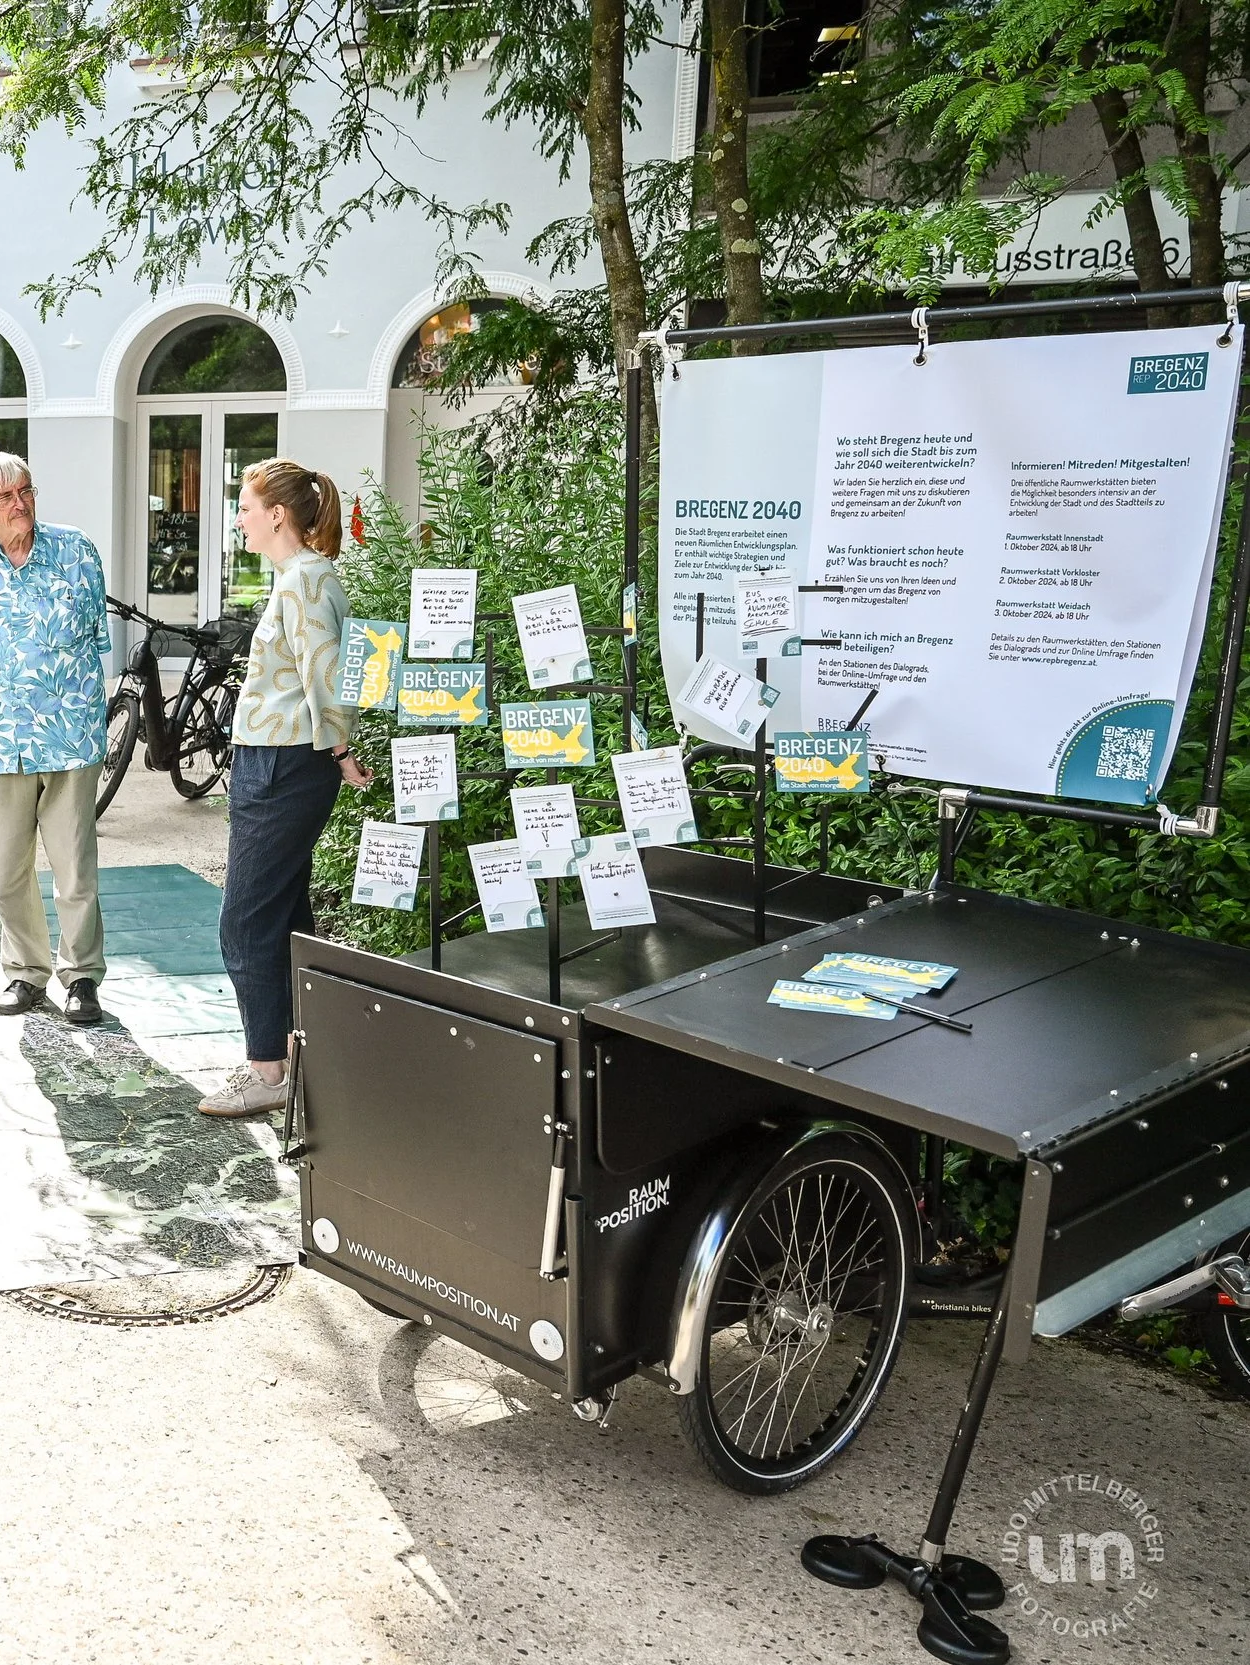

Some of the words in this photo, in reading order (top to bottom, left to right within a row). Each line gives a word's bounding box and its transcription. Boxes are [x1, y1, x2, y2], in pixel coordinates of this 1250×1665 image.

[1161, 237, 1180, 266] 6
[1134, 356, 1204, 373] BREGENZ
[1133, 374, 1150, 383] REP
[1155, 371, 1203, 390] 2040
[837, 437, 851, 445] Wo
[853, 437, 877, 445] steht
[880, 436, 921, 446] Bregenz
[924, 434, 951, 443] heute
[954, 433, 972, 443] und
[853, 449, 869, 457] soll
[872, 447, 890, 456] sich
[894, 448, 908, 456] die
[911, 447, 937, 455] Stadt
[940, 446, 953, 455] bis
[835, 461, 855, 469] Jahr
[857, 460, 882, 469] 2040
[885, 458, 975, 469] weiterentwickeln?
[1011, 461, 1065, 471] Informieren!
[1068, 460, 1117, 469] Mitreden!
[1120, 458, 1190, 470] Mitgestalten!
[868, 478, 879, 486] Sie
[882, 478, 912, 486] herzlich
[950, 477, 965, 485] und
[860, 489, 885, 498] Fragen
[887, 488, 900, 496] mit
[928, 488, 970, 496] diskutieren
[676, 500, 748, 519] BREGENZ
[753, 501, 801, 519] 2040
[831, 499, 844, 507] und
[846, 500, 889, 508] gemeinsam
[917, 498, 946, 506] Zukunft
[831, 510, 858, 519] Bregenz
[871, 509, 905, 517] arbeiten!
[689, 528, 706, 536] Stadt
[707, 529, 730, 538] Bregenz
[732, 530, 765, 538] erarbeitet
[1006, 533, 1062, 541] Raumwerkstatt
[1064, 534, 1103, 542] Innenstadt
[698, 540, 732, 548] Räumlichen
[734, 541, 797, 550] Entwicklungsplan.
[828, 545, 845, 554] Was
[848, 545, 905, 555] funktioniert
[908, 546, 934, 555] schon
[937, 546, 963, 555] heute
[1010, 543, 1039, 551] Oktober
[1079, 544, 1092, 552] Uhr
[685, 550, 707, 558] enthält
[709, 552, 733, 561] wichtige
[734, 554, 768, 562] Strategien
[826, 557, 845, 567] gut?
[848, 557, 867, 566] Was
[870, 558, 907, 566] braucht
[922, 559, 948, 567] noch?
[674, 560, 691, 568] Ziele
[705, 563, 740, 572] Entwicklung
[1001, 567, 1060, 576] Raumwerkstatt
[1062, 568, 1100, 577] Vorkloster
[1008, 577, 1036, 585] Oktober
[1080, 579, 1092, 587] Uhr
[996, 600, 1055, 609] Raumwerkstatt
[1058, 602, 1091, 610] Weidach
[821, 629, 837, 638] Wie
[840, 630, 861, 640] kann
[864, 632, 877, 640] ich
[881, 633, 902, 642] mich
[917, 634, 953, 646] Bregenz
[844, 643, 894, 655] beteiligen?
[341, 622, 367, 701] BREGENZ
[988, 652, 999, 660] Sie
[1001, 654, 1020, 662] unter
[360, 661, 381, 702] 2040
[403, 671, 485, 688] BREGENZ
[404, 689, 447, 706] 2040
[505, 707, 588, 728] BREGENZ
[1048, 760, 1057, 770] Hier
[1055, 738, 1068, 752] gehts
[1066, 720, 1082, 736] direkt
[1082, 711, 1092, 721] zur
[1092, 692, 1150, 714] Online-Umfrage!
[508, 729, 551, 747] 2040
[778, 738, 864, 755] BREGENZ
[779, 757, 825, 773] 2040
[849, 955, 949, 975] BREGENZ
[780, 983, 866, 998] BREGEN
[629, 1174, 670, 1204] RAUM
[599, 1192, 670, 1233] POSITION.
[346, 1238, 520, 1331] WWW.RAUMPOSITION.AT
[931, 1303, 969, 1311] christiania
